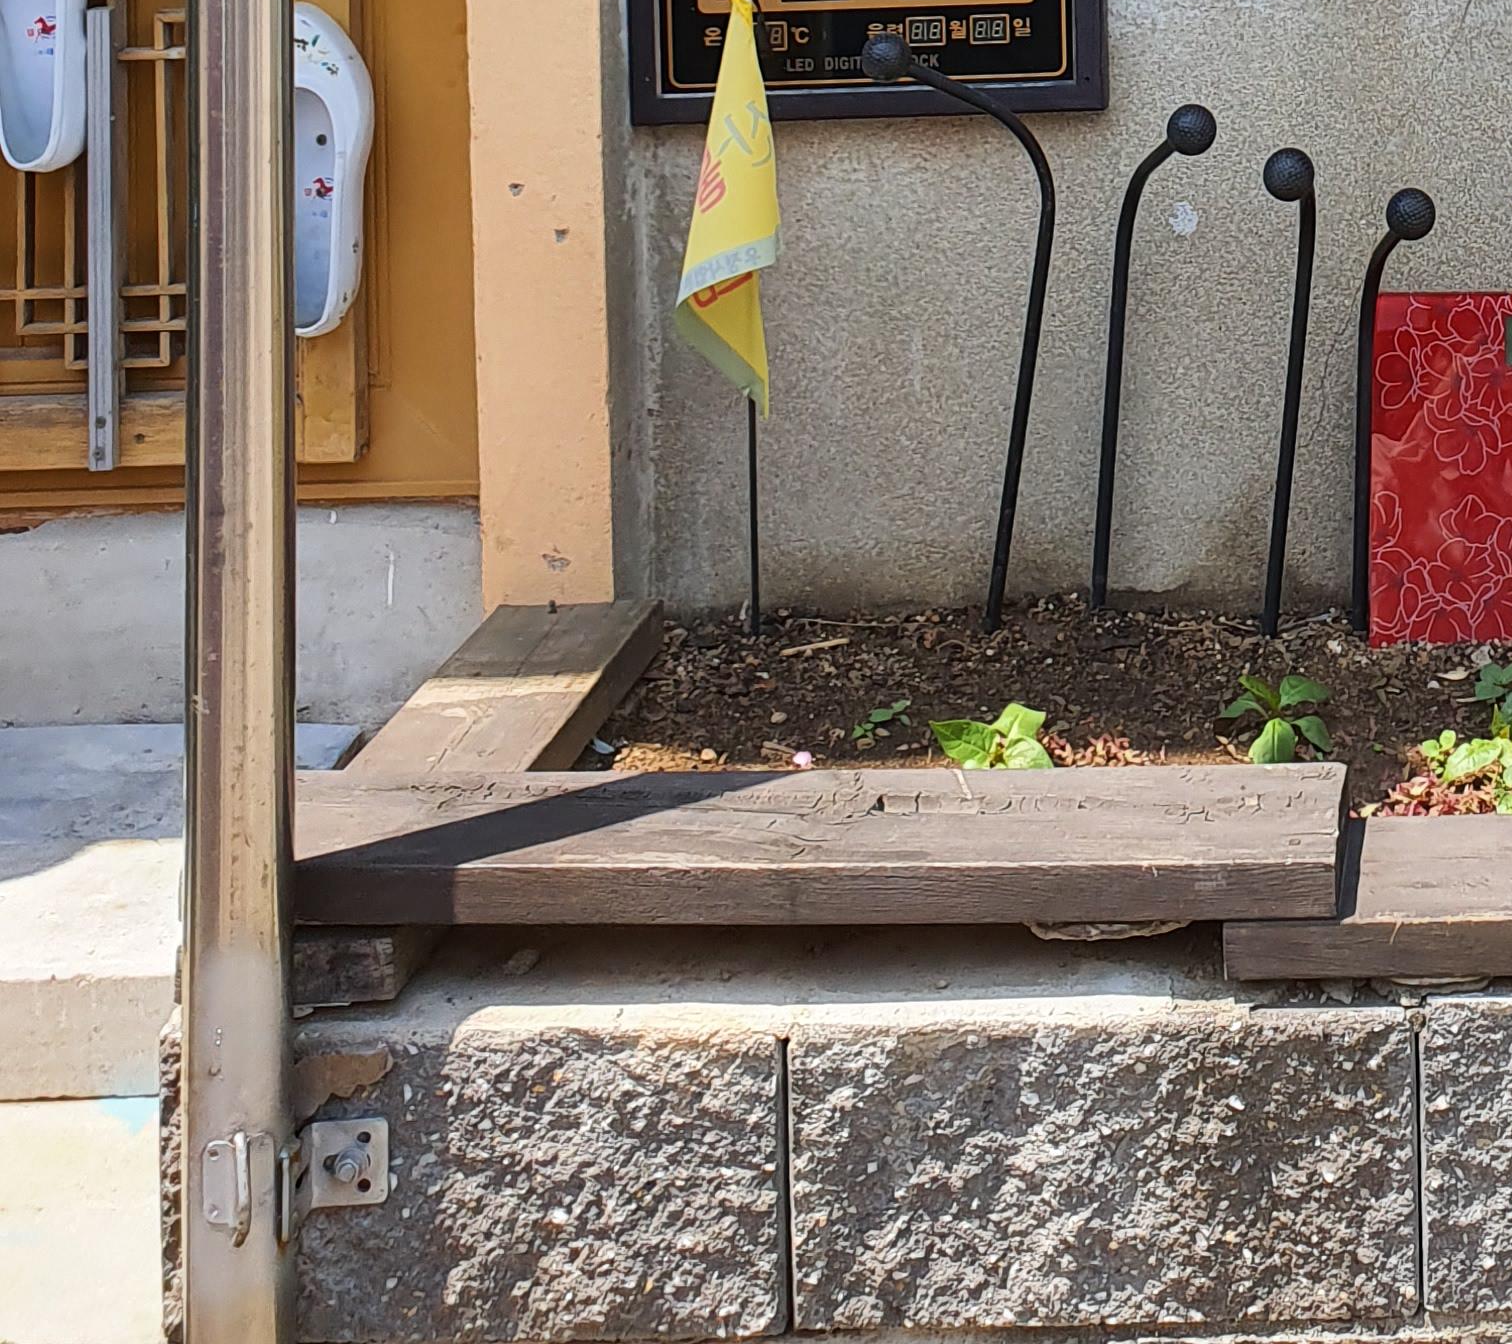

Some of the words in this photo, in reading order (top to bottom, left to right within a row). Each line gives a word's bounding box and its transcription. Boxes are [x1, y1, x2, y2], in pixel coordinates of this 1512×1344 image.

[949, 19, 967, 40] 월
[1012, 16, 1032, 38] 일
[786, 57, 815, 72] LED
